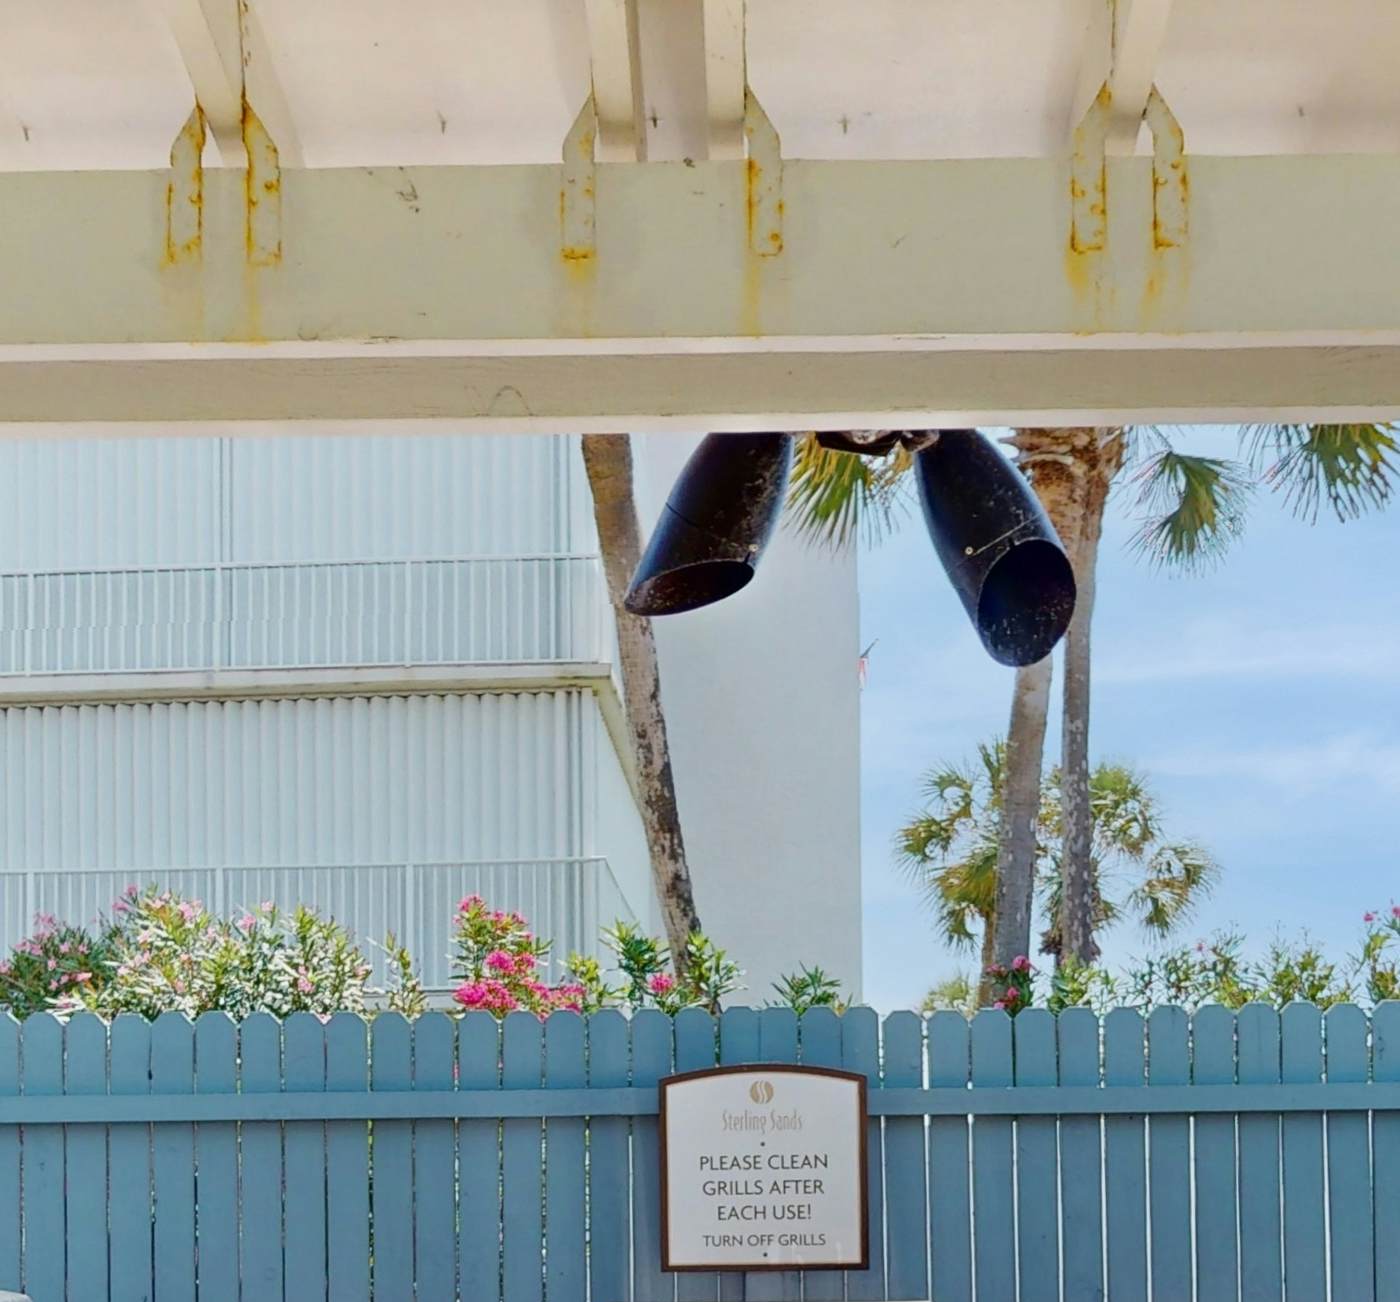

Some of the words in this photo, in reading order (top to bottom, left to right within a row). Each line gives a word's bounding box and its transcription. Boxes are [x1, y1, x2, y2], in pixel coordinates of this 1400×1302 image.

[722, 1109, 766, 1134] Sterling
[769, 1109, 803, 1131] Sands
[699, 1154, 763, 1171] PLEASE
[767, 1153, 829, 1170] CLEAN
[702, 1179, 764, 1197] GRILLS
[768, 1179, 825, 1195] AFTER
[716, 1204, 767, 1221] EACH
[772, 1203, 812, 1220] USE!
[703, 1234, 743, 1248] TURN
[746, 1234, 774, 1247] OFF
[778, 1233, 827, 1246] GRILLS
